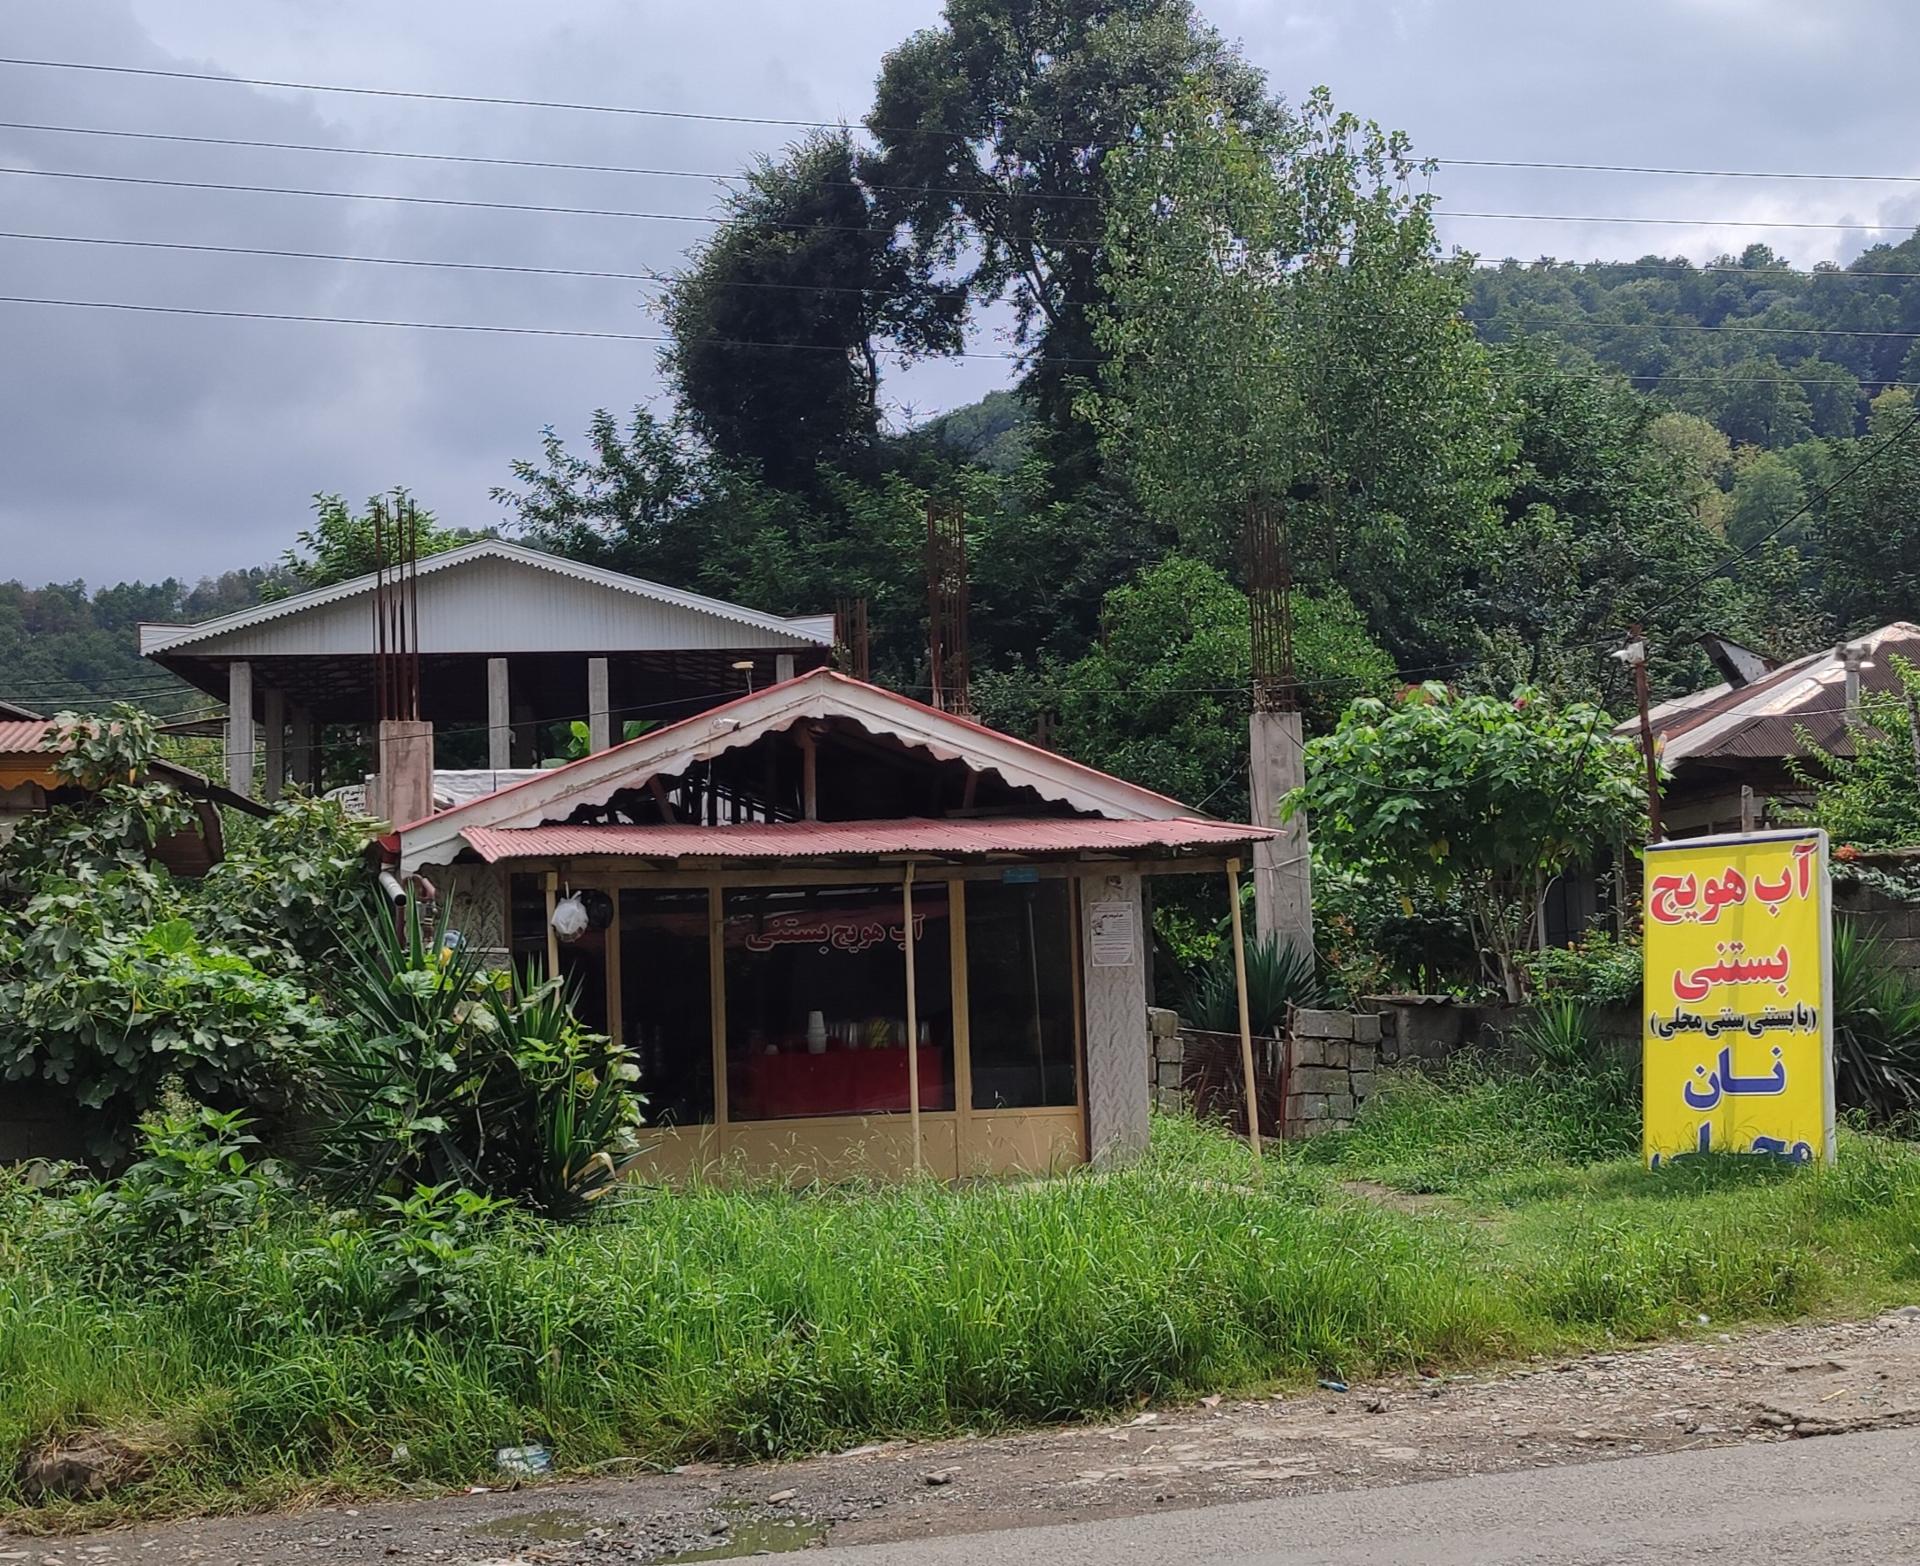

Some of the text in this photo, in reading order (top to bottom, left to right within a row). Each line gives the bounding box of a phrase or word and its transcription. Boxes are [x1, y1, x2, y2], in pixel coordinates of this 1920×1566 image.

[1650, 842, 1817, 924] آب هویج
[745, 919, 831, 954] بستنی
[831, 922, 886, 953] هویج
[1673, 942, 1791, 1003] بستنی
[1748, 1007, 1796, 1038] بستنی
[1683, 1046, 1787, 1111] نان
